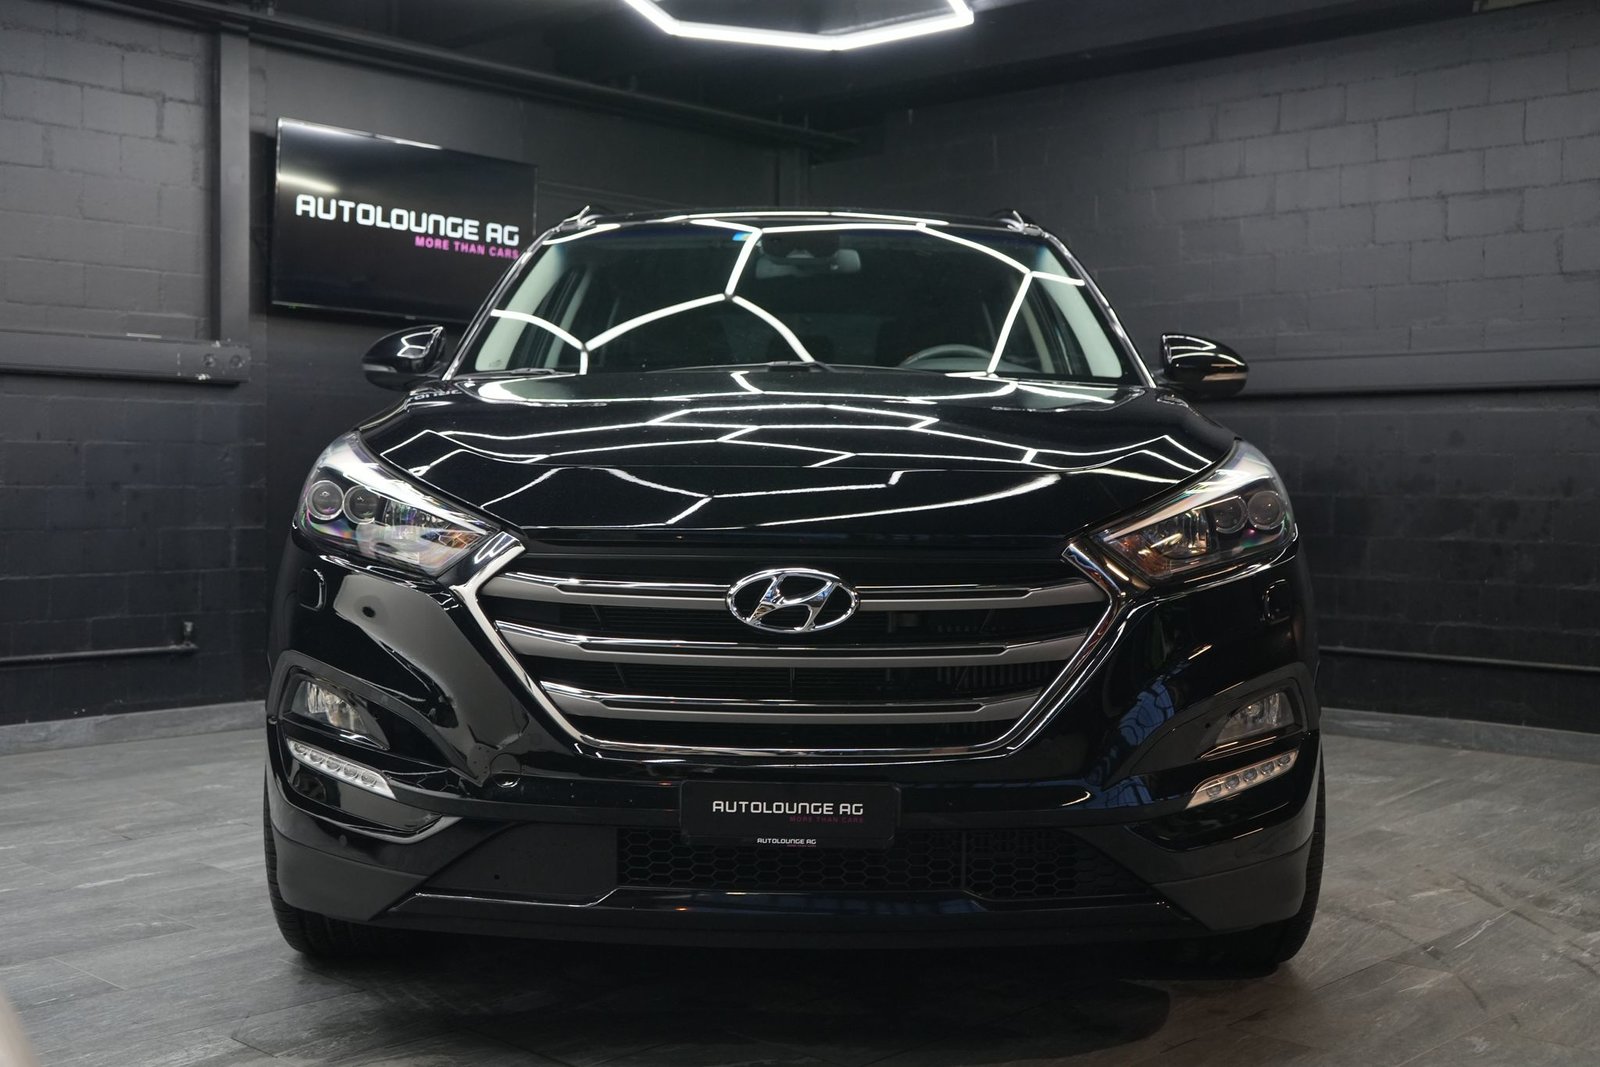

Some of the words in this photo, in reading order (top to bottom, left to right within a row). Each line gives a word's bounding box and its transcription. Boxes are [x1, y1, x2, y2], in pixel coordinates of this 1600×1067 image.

[295, 194, 479, 241] AUTOLOUNGE
[486, 222, 519, 246] AG
[415, 235, 450, 251] MORE
[453, 241, 485, 256] THAN
[488, 245, 519, 260] CARS
[712, 801, 834, 815] AUTOLOUNGE
[839, 803, 864, 815] AG
